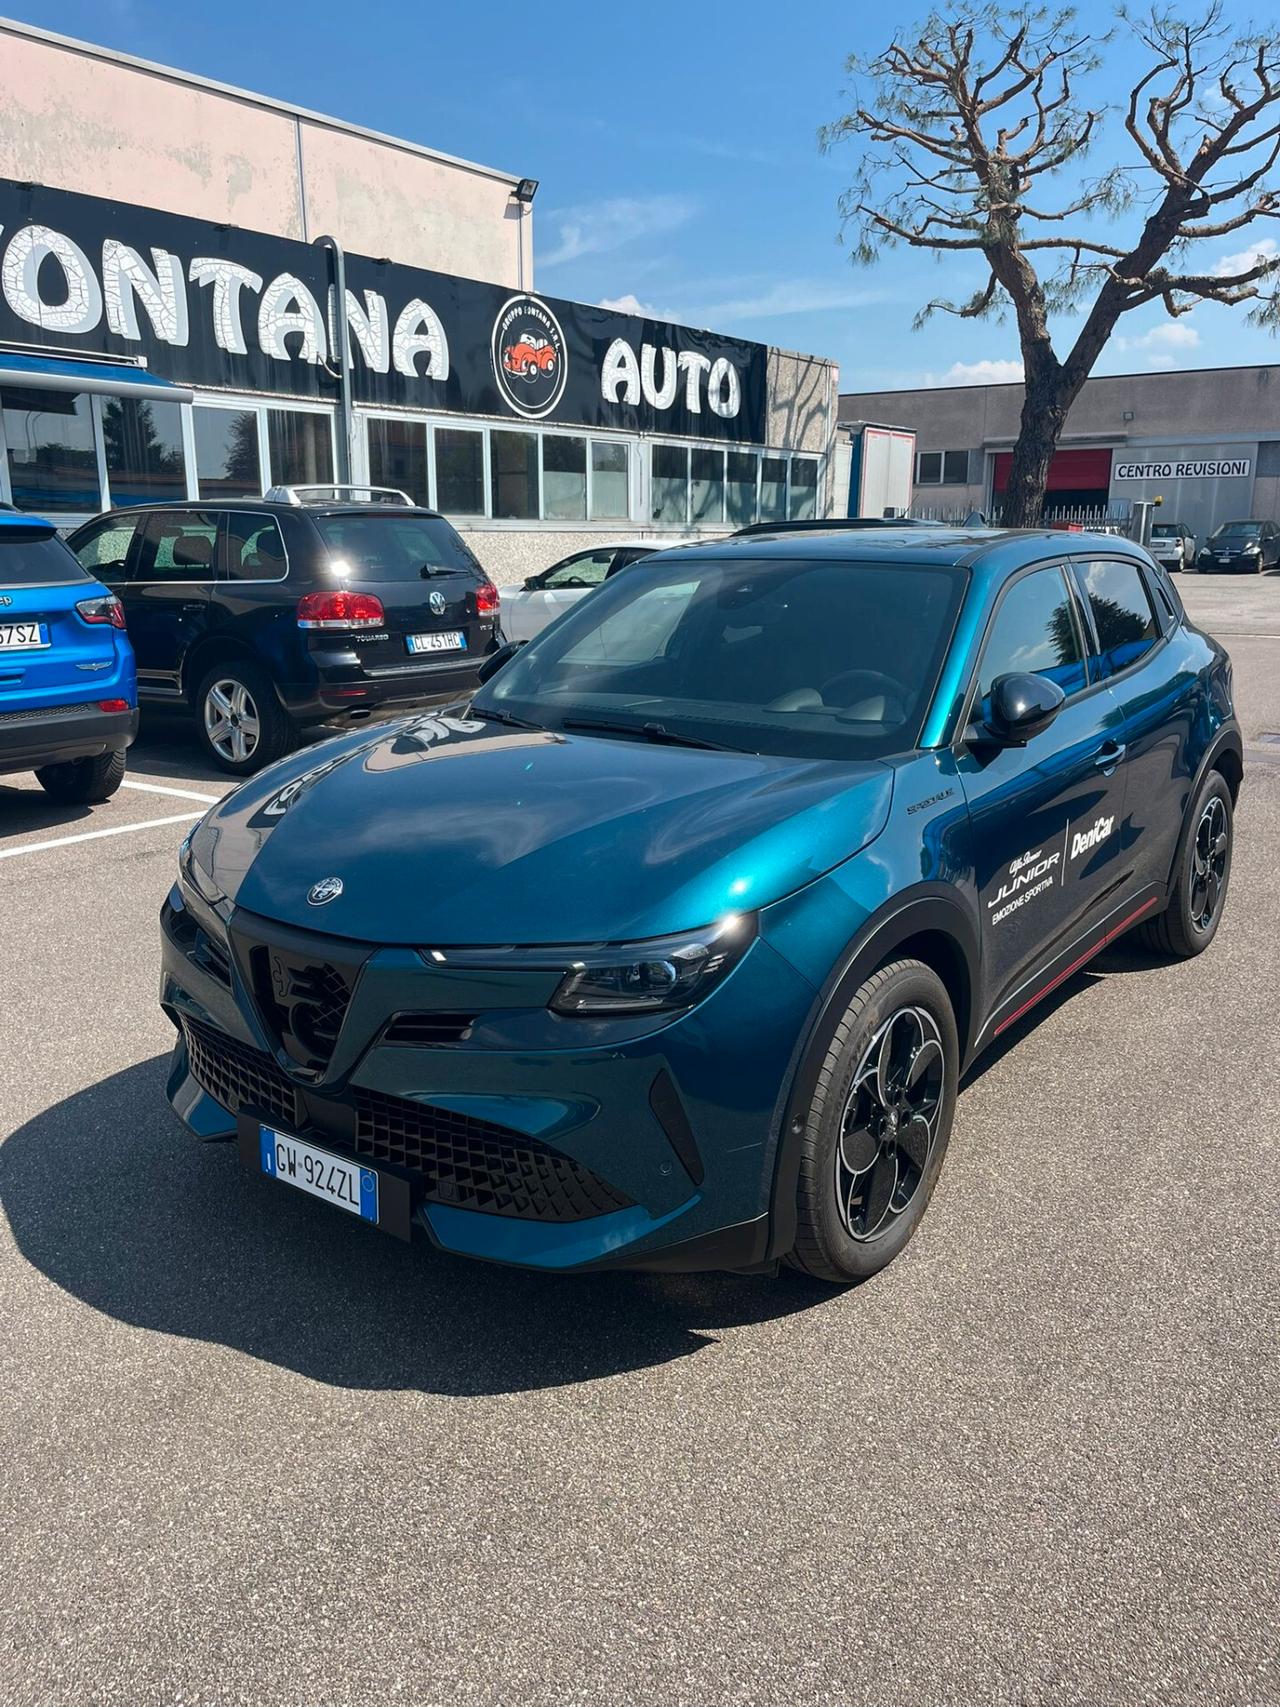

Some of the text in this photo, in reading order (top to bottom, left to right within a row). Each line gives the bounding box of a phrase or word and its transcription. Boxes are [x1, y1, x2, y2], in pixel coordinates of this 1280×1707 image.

[0, 224, 449, 381] ONTANA
[502, 306, 523, 330] GRUPPO
[524, 306, 551, 328] FONTANA
[601, 338, 741, 418] AUTO
[1118, 461, 1246, 478] CENTRO REVISIONI
[1070, 815, 1115, 860] DeniCar
[988, 852, 1060, 908] JUNIOR
[992, 876, 1053, 926] EMOZIONE SPORTIVA
